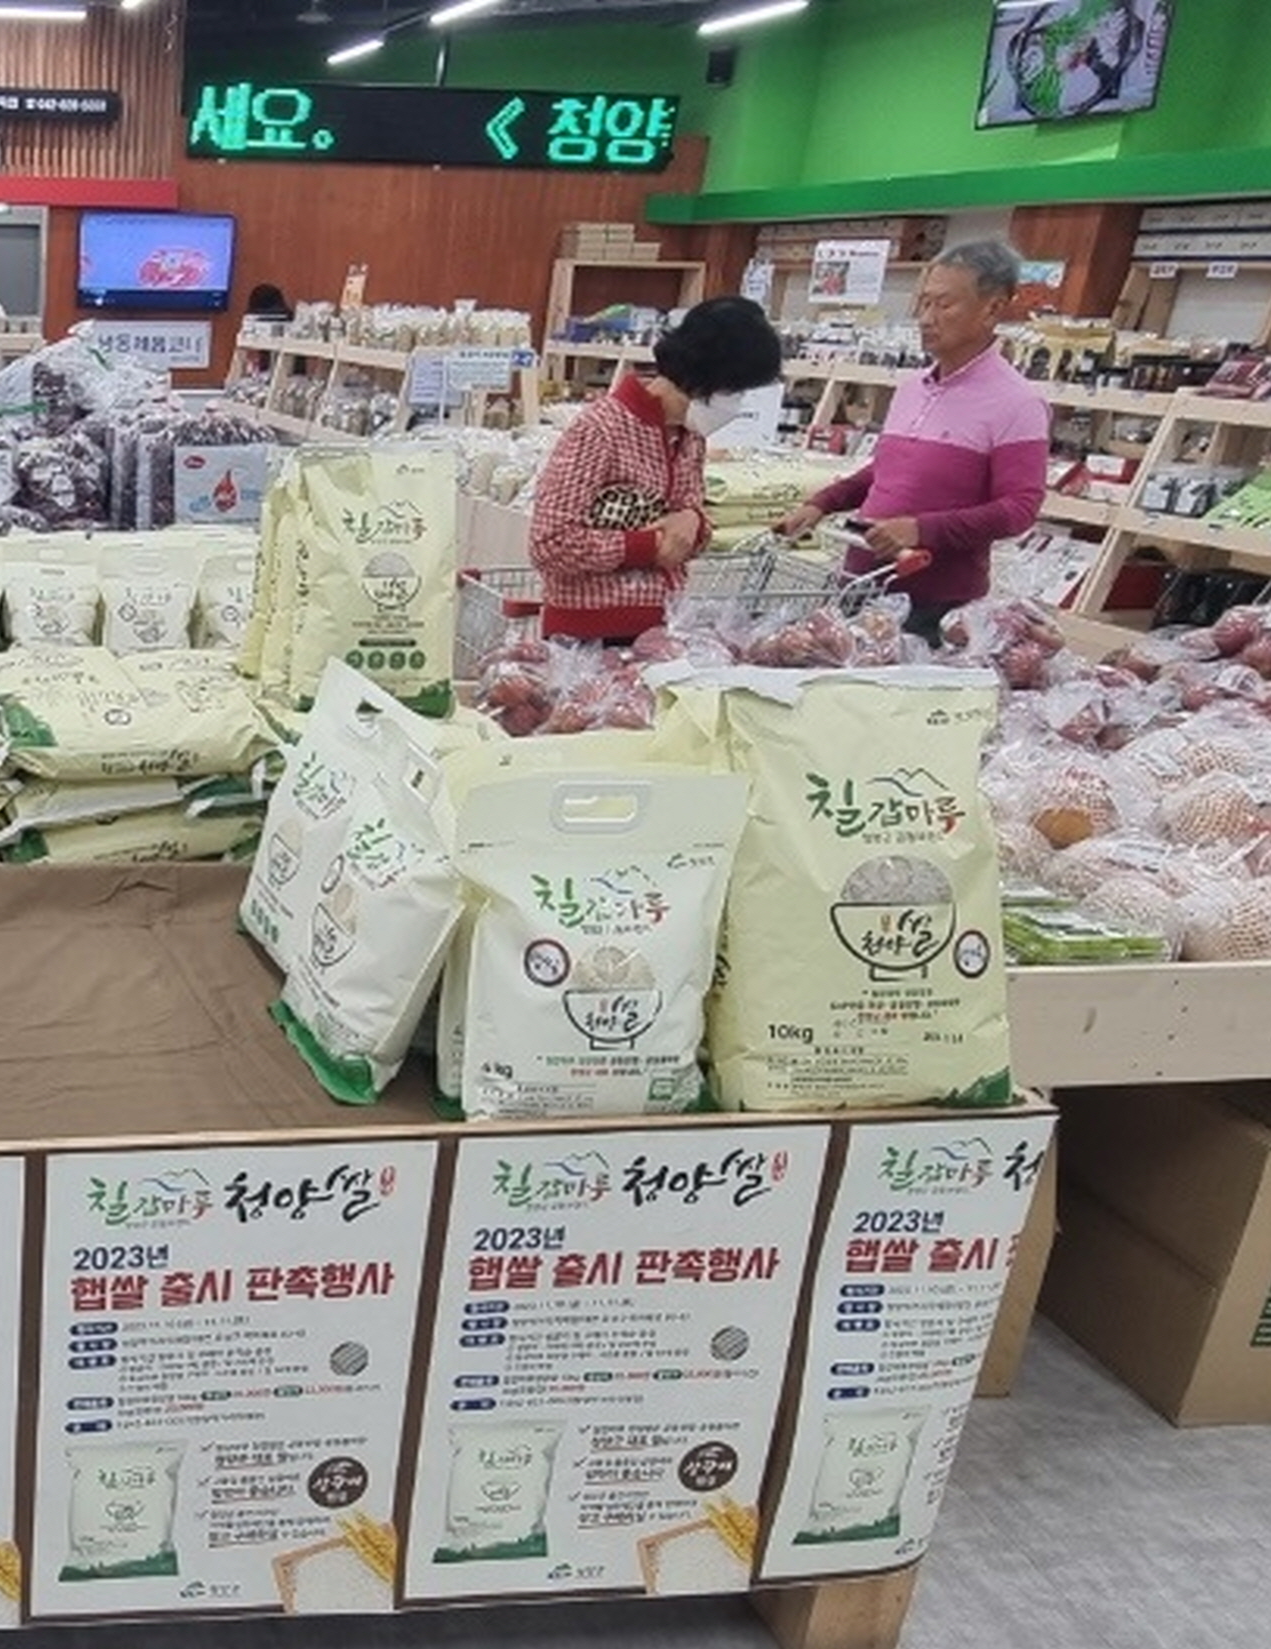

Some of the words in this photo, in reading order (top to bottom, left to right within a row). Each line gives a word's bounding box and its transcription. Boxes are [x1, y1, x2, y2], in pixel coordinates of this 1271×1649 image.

[548, 95, 676, 164] 청양
[806, 773, 966, 838] 칠갑마루
[768, 1024, 815, 1045] 10kg
[492, 1159, 612, 1208] 칠갑마루
[622, 1148, 772, 1208] 청양쌀
[878, 1145, 995, 1192] 칠갑마루
[86, 1176, 213, 1227] 칠갑마루
[224, 1164, 380, 1224] 청양쌀
[473, 1226, 567, 1253] 2023년
[852, 1209, 945, 1235] 2023년
[73, 1243, 169, 1271] 2023년
[467, 1254, 543, 1292] 햅쌀
[551, 1250, 623, 1288] 출시
[635, 1246, 781, 1286] 판촉행사
[844, 1238, 921, 1274] 햅쌀
[928, 1236, 999, 1273] 출시
[70, 1273, 150, 1313] 햅쌀
[160, 1268, 232, 1308] 출시
[246, 1261, 395, 1302] 판촉행사
